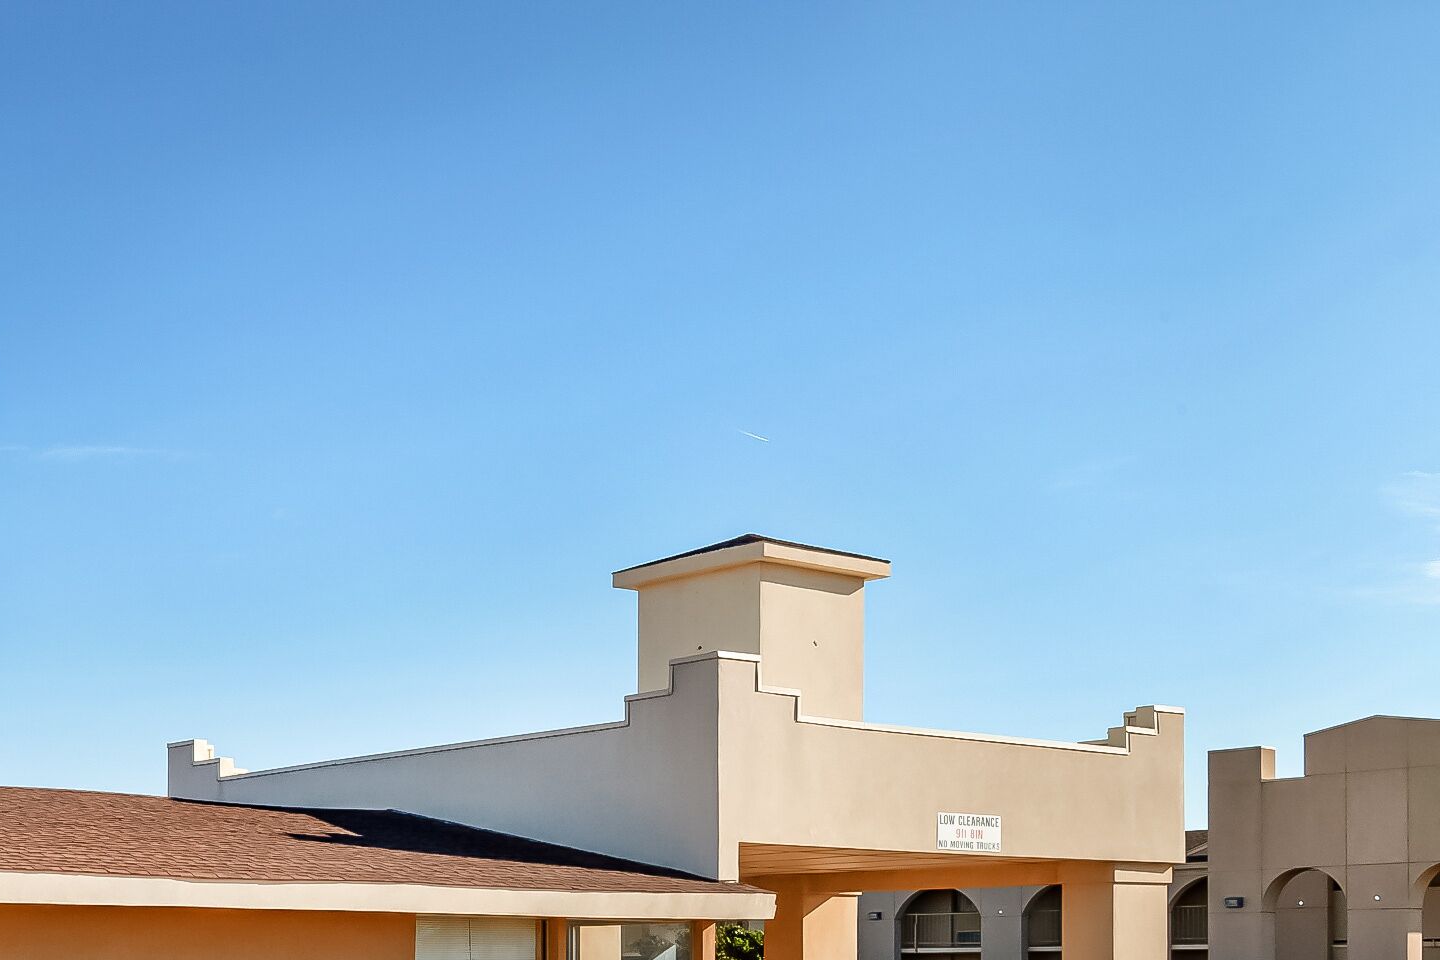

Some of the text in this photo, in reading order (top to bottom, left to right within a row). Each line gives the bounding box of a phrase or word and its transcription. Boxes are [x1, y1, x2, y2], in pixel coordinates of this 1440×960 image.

[940, 814, 999, 827] LOW CLEARANCE
[939, 840, 948, 848] NO
[950, 840, 974, 849] MOVING
